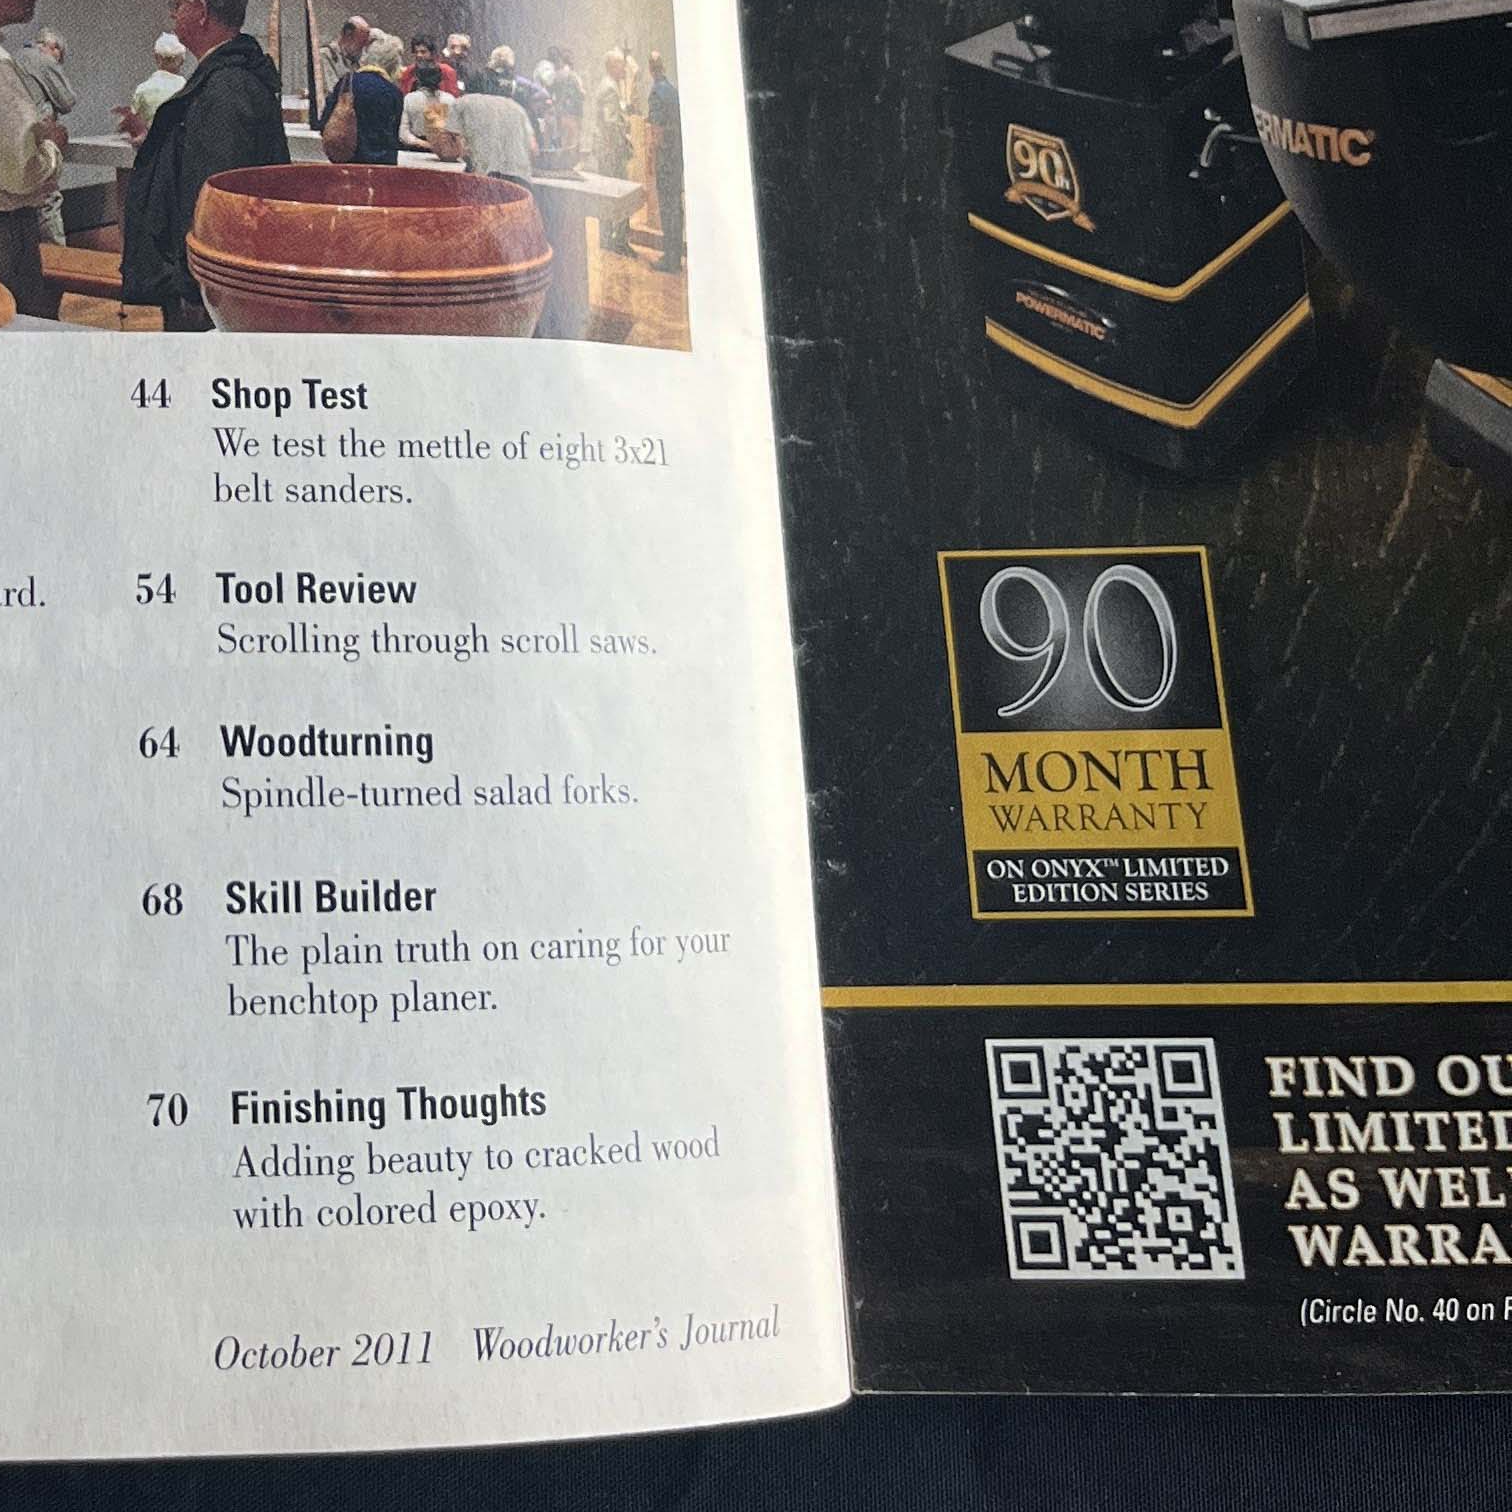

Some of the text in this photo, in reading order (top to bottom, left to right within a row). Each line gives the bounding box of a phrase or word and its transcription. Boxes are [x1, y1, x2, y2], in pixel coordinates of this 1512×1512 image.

[130, 377, 369, 418] 44 Shop Test
[212, 426, 670, 472] We test the mettle of eight 3x21
[136, 571, 417, 606] 54 Tool Review
[217, 621, 657, 663] Scrolling through scroll saws.
[978, 565, 1178, 718] 90
[139, 723, 434, 765] 64 Woodturning
[980, 748, 1215, 794] MONTH
[987, 801, 1208, 834] WARRANTY
[986, 859, 1025, 880] ON
[1122, 856, 1229, 878] LIMITED
[142, 878, 437, 917] 68 Skill Builder
[1011, 881, 1209, 904] EDITION SERIES
[225, 924, 731, 976] The plain truth on caring for your
[1263, 1055, 1416, 1098] FIND
[146, 1083, 547, 1131] 70 Finishing Thoughts
[1284, 1166, 1512, 1211] AS WEL
[1287, 1222, 1512, 1268] WARRA
[1300, 1297, 1377, 1327] (Circle
[1385, 1297, 1425, 1323] No.
[1432, 1297, 1460, 1322] 40
[1466, 1302, 1495, 1322] on
[214, 1303, 781, 1371] October 2011 Woodworker's Journal
